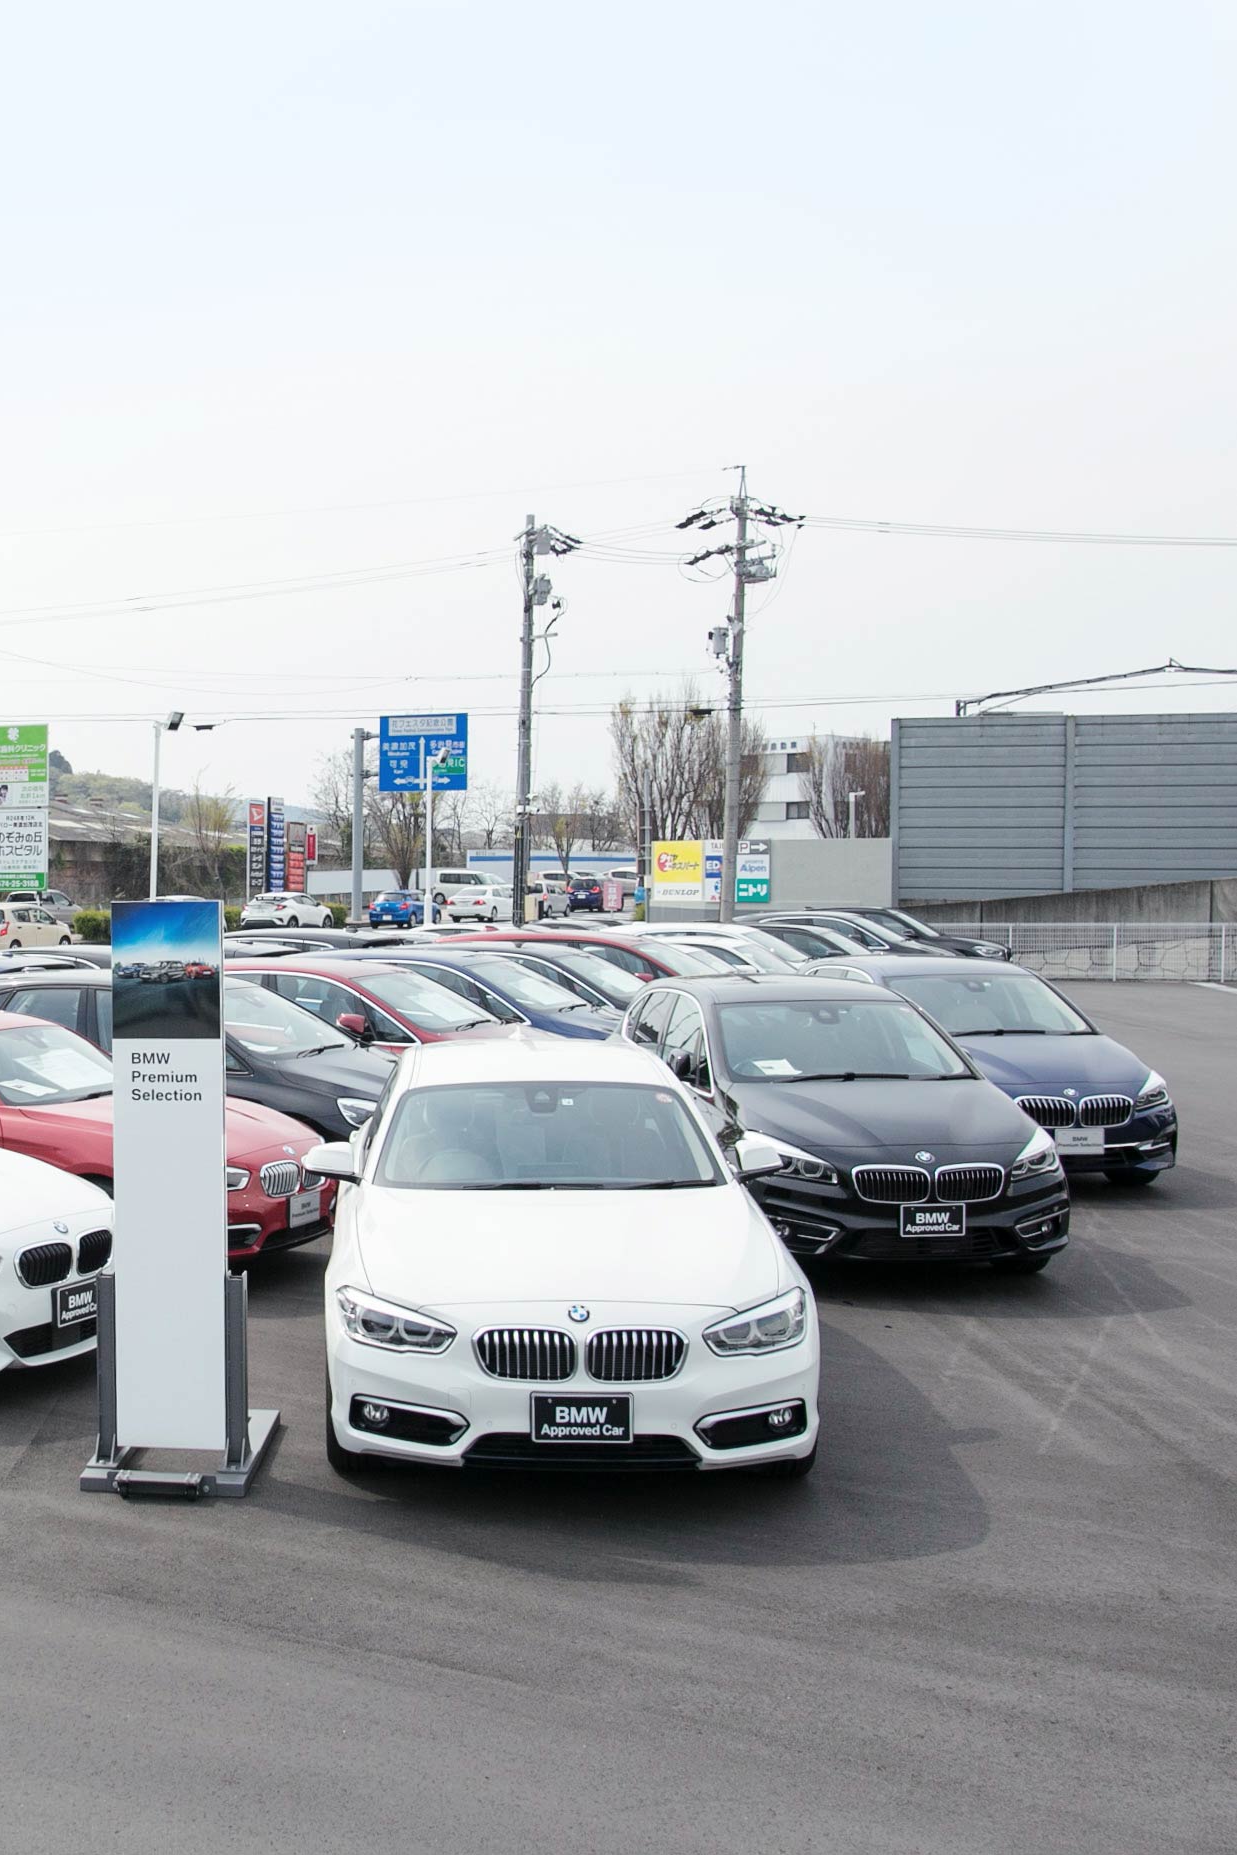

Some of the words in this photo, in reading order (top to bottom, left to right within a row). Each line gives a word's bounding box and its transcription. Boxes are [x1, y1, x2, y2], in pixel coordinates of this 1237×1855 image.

[740, 843, 748, 852] P
[740, 864, 767, 873] Alpen
[738, 884, 767, 897] ニトリ
[131, 1052, 171, 1065] BMW
[131, 1071, 197, 1083] Premium
[131, 1088, 202, 1101] Selection
[915, 1212, 950, 1224] BMW
[905, 1224, 944, 1233] Approved
[945, 1223, 960, 1231] Car
[68, 1290, 93, 1309] BMW
[61, 1305, 90, 1320] Approved
[555, 1406, 608, 1424] BMW
[541, 1424, 601, 1438] Approved
[602, 1424, 625, 1436] Car
